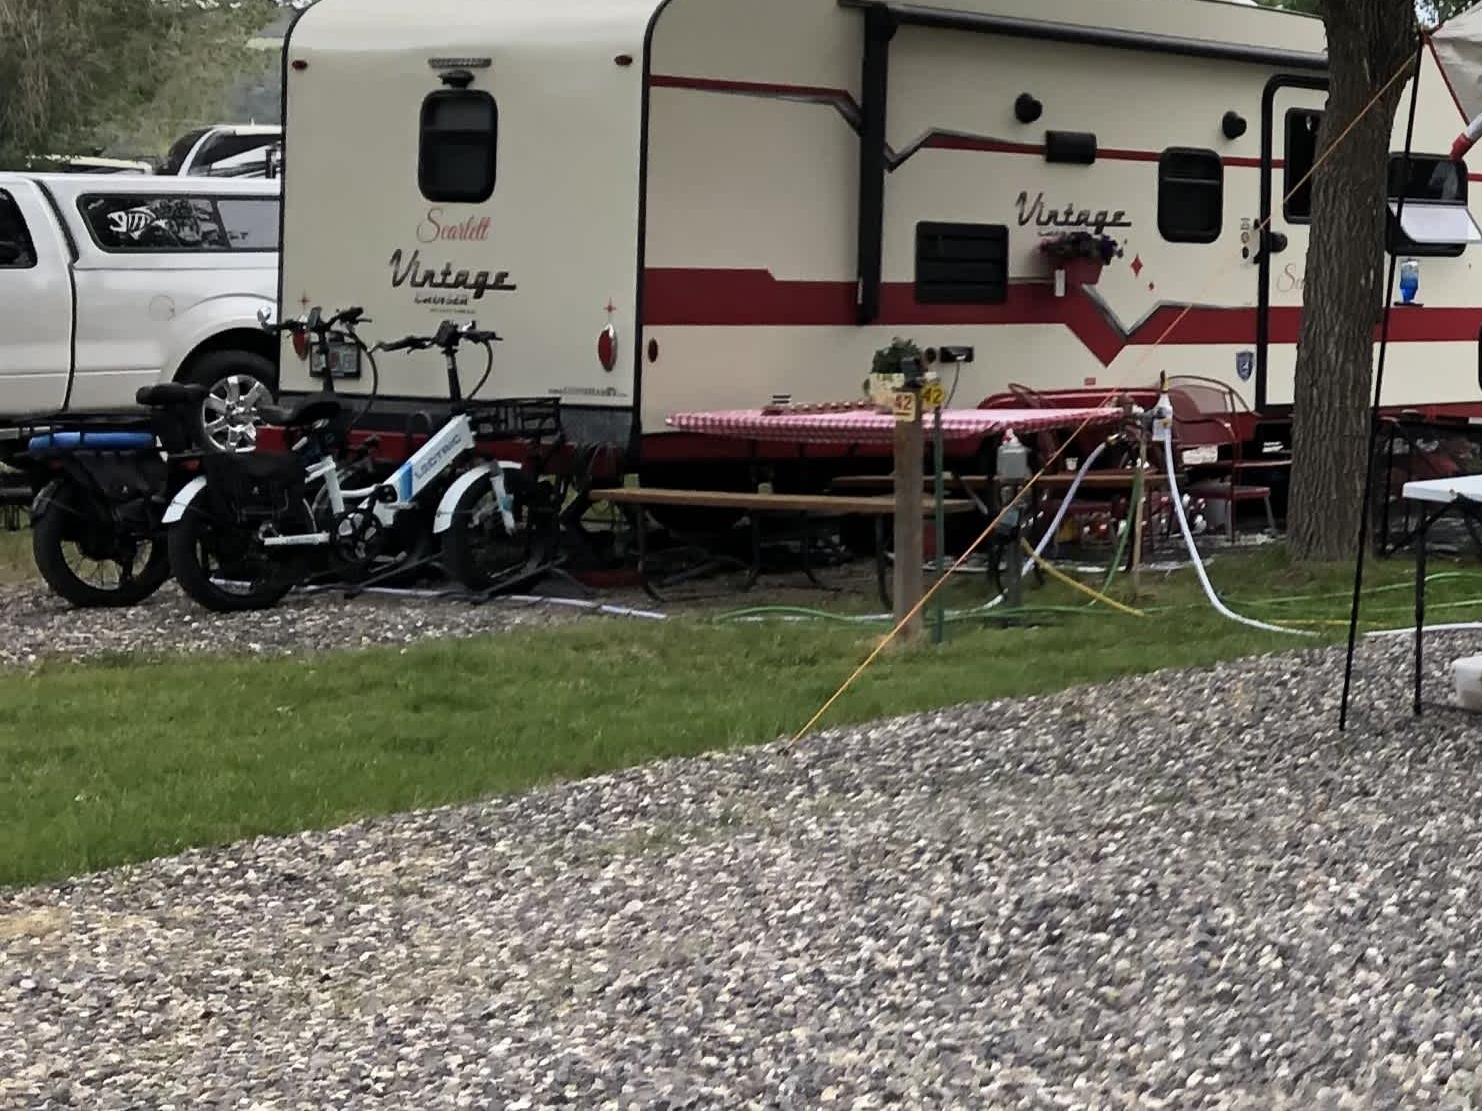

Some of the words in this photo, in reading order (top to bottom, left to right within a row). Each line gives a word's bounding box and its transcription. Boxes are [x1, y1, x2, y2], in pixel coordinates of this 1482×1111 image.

[416, 207, 492, 243] Scarlett
[1015, 191, 1132, 234] Vintage
[388, 248, 517, 300] Vintage
[895, 394, 912, 410] 42
[923, 387, 942, 404] 42
